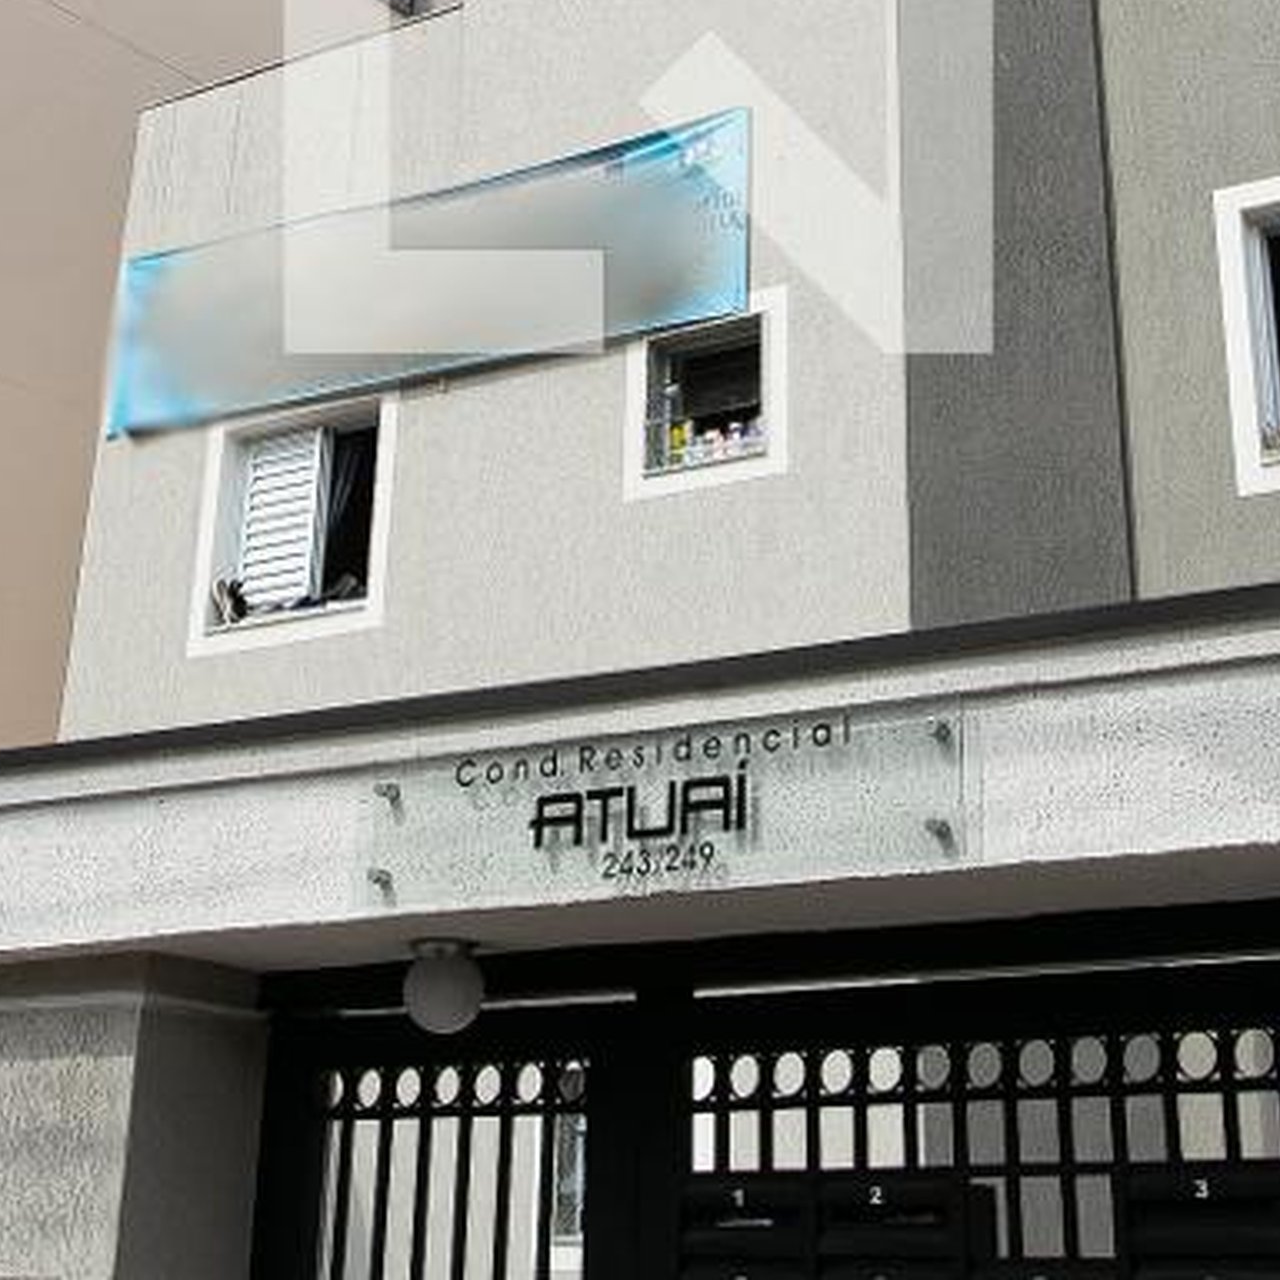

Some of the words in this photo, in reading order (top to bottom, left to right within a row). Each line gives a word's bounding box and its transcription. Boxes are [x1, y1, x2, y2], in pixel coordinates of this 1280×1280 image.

[579, 715, 851, 772] Residencial
[732, 1189, 744, 1207] 1
[869, 1186, 883, 1205] 2
[1195, 1179, 1209, 1198] 3
